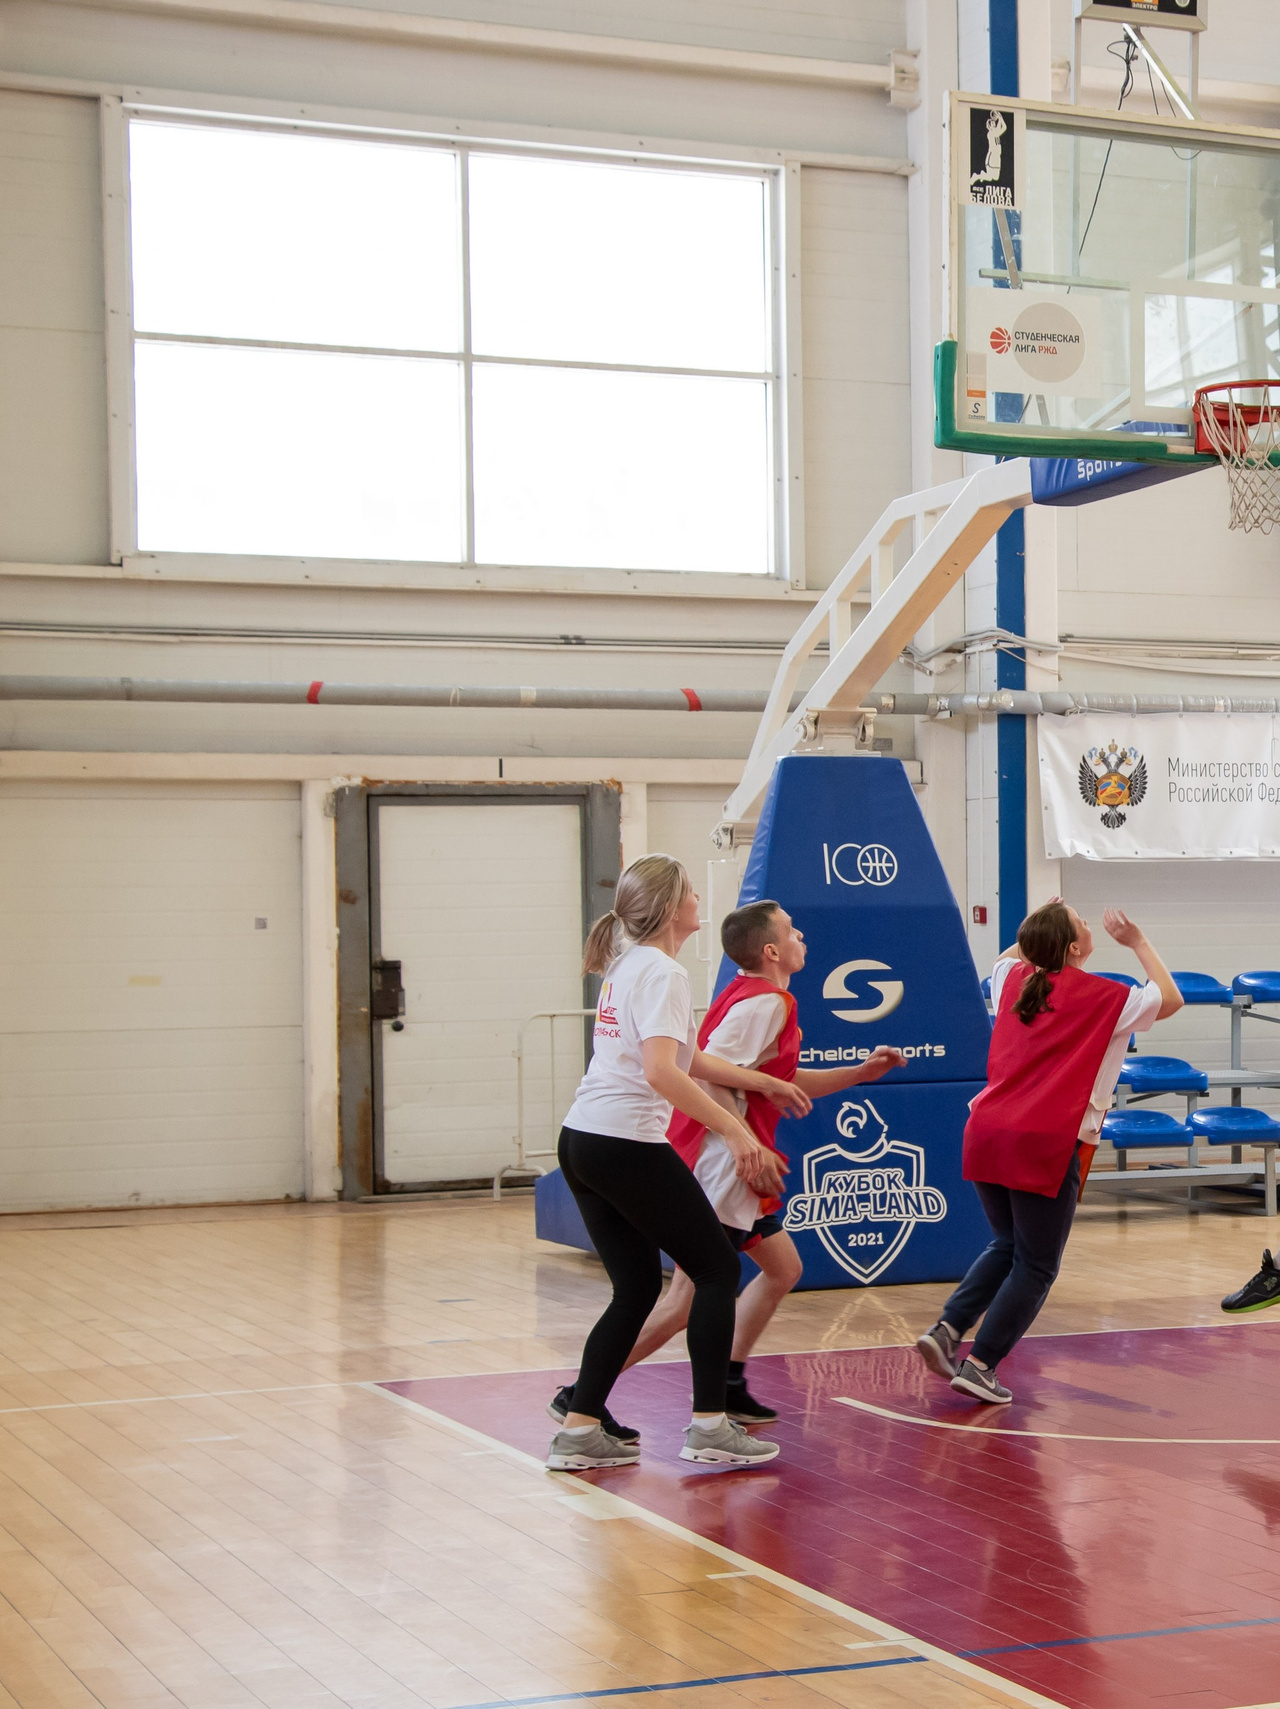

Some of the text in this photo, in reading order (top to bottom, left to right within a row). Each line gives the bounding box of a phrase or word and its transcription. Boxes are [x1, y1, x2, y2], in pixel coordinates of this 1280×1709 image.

[1132, 2, 1158, 11] ЭЛЕКТРО
[985, 185, 1013, 198] ЛИГА
[969, 192, 1014, 207] БЕЛОВА
[1014, 331, 1080, 343] СТУДЕНЧЕСКАЯ
[1014, 343, 1058, 355] ЛИГА РЖД
[1167, 757, 1269, 783] Министерство
[1168, 781, 1253, 803] Российской
[798, 1045, 871, 1063] chelde
[826, 1172, 904, 1195] КУБОК
[783, 1190, 946, 1230] SIMA-LAND
[847, 1232, 885, 1247] 2021
